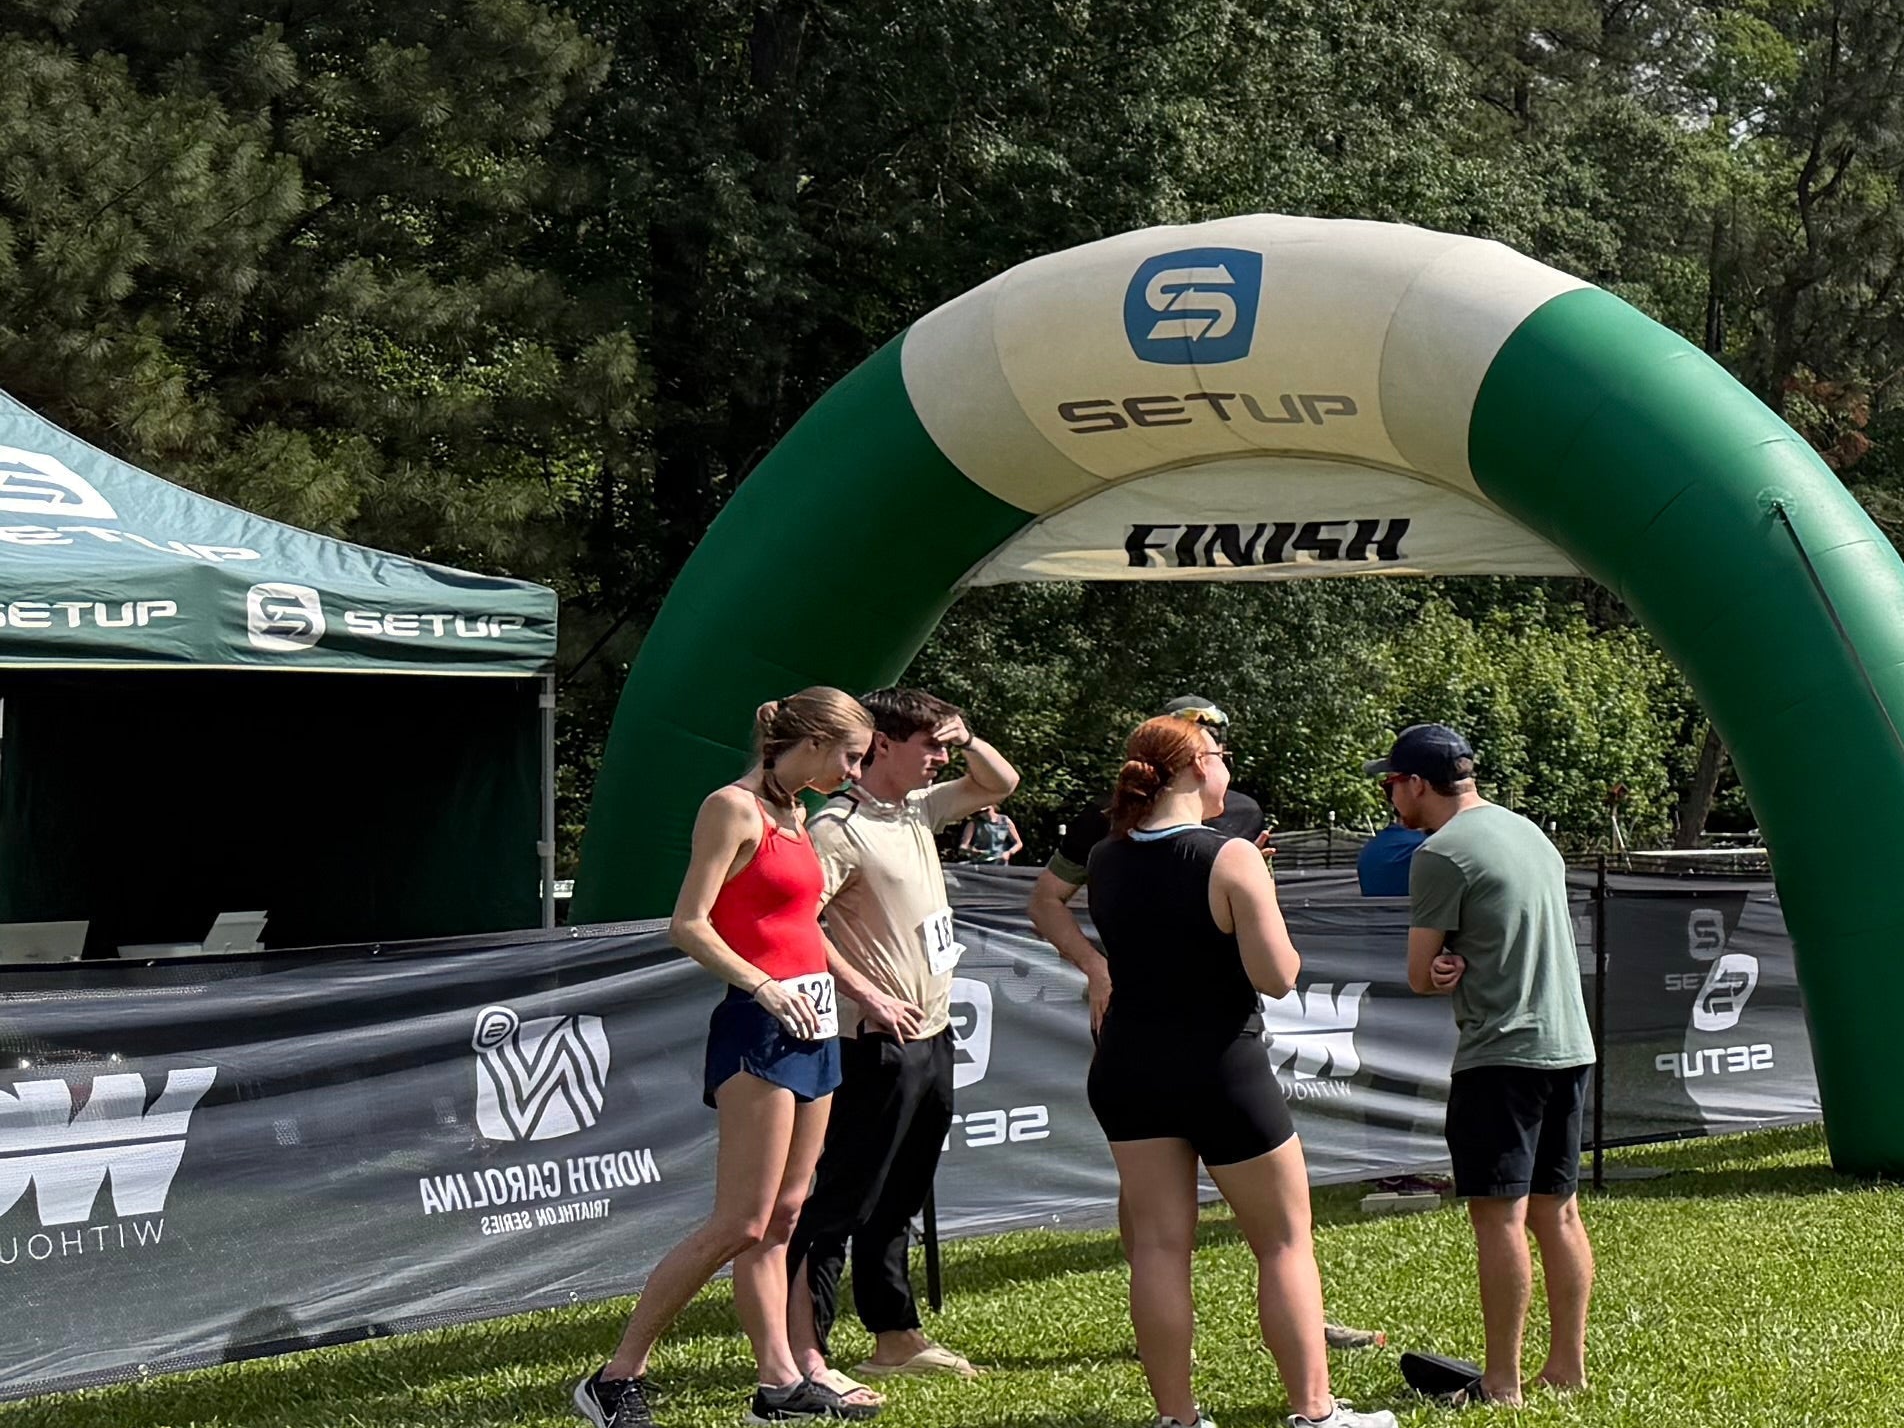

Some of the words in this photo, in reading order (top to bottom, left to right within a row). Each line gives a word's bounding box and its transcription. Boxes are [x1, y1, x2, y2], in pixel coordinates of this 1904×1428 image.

[1058, 392, 1358, 435] SETUP
[0, 525, 262, 562] ETUP
[1125, 518, 1410, 568] FINISH
[0, 599, 178, 628] ETUP
[344, 611, 526, 638] SETUP
[797, 978, 832, 1014] 22
